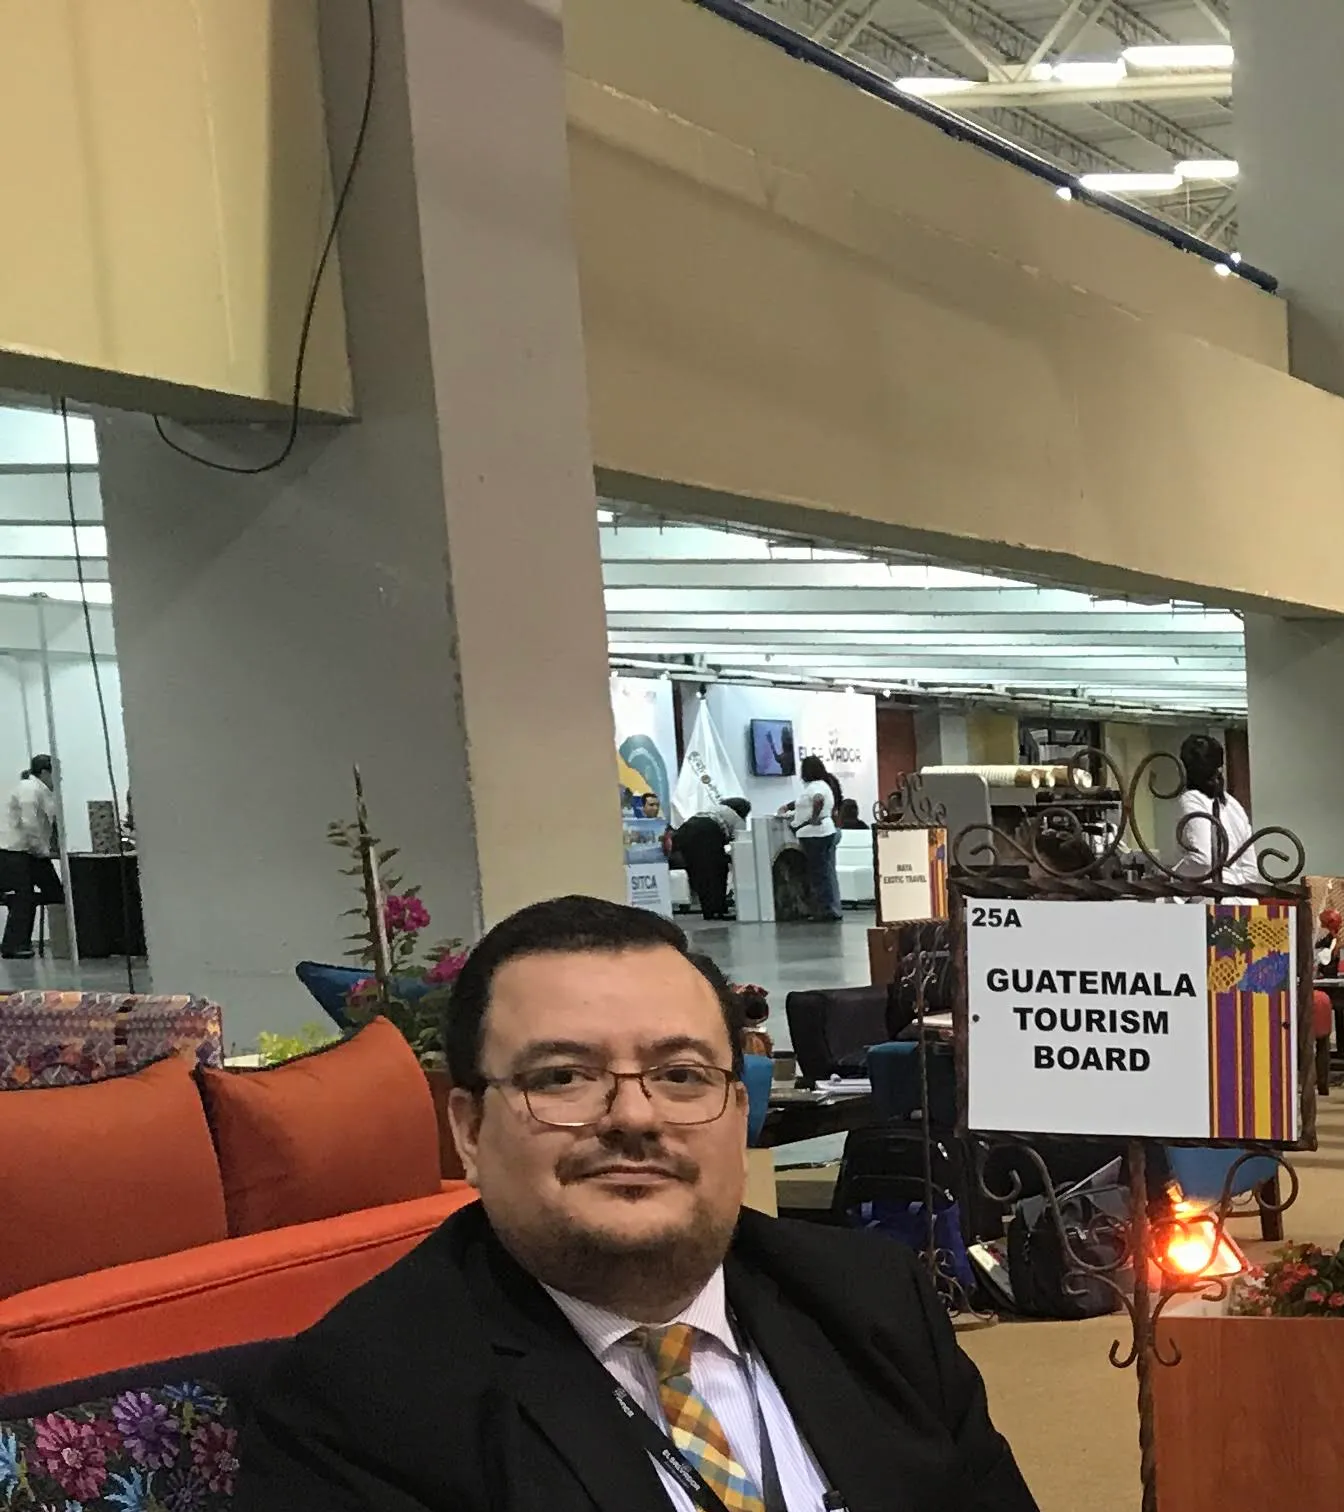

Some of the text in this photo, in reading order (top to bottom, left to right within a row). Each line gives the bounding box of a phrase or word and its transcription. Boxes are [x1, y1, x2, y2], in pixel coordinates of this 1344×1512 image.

[631, 874, 658, 891] SITCA
[971, 907, 1022, 929] 25A
[985, 967, 1197, 998] GUATEMALA
[1012, 1006, 1170, 1035] TOURISM
[1033, 1045, 1151, 1073] BOARD
